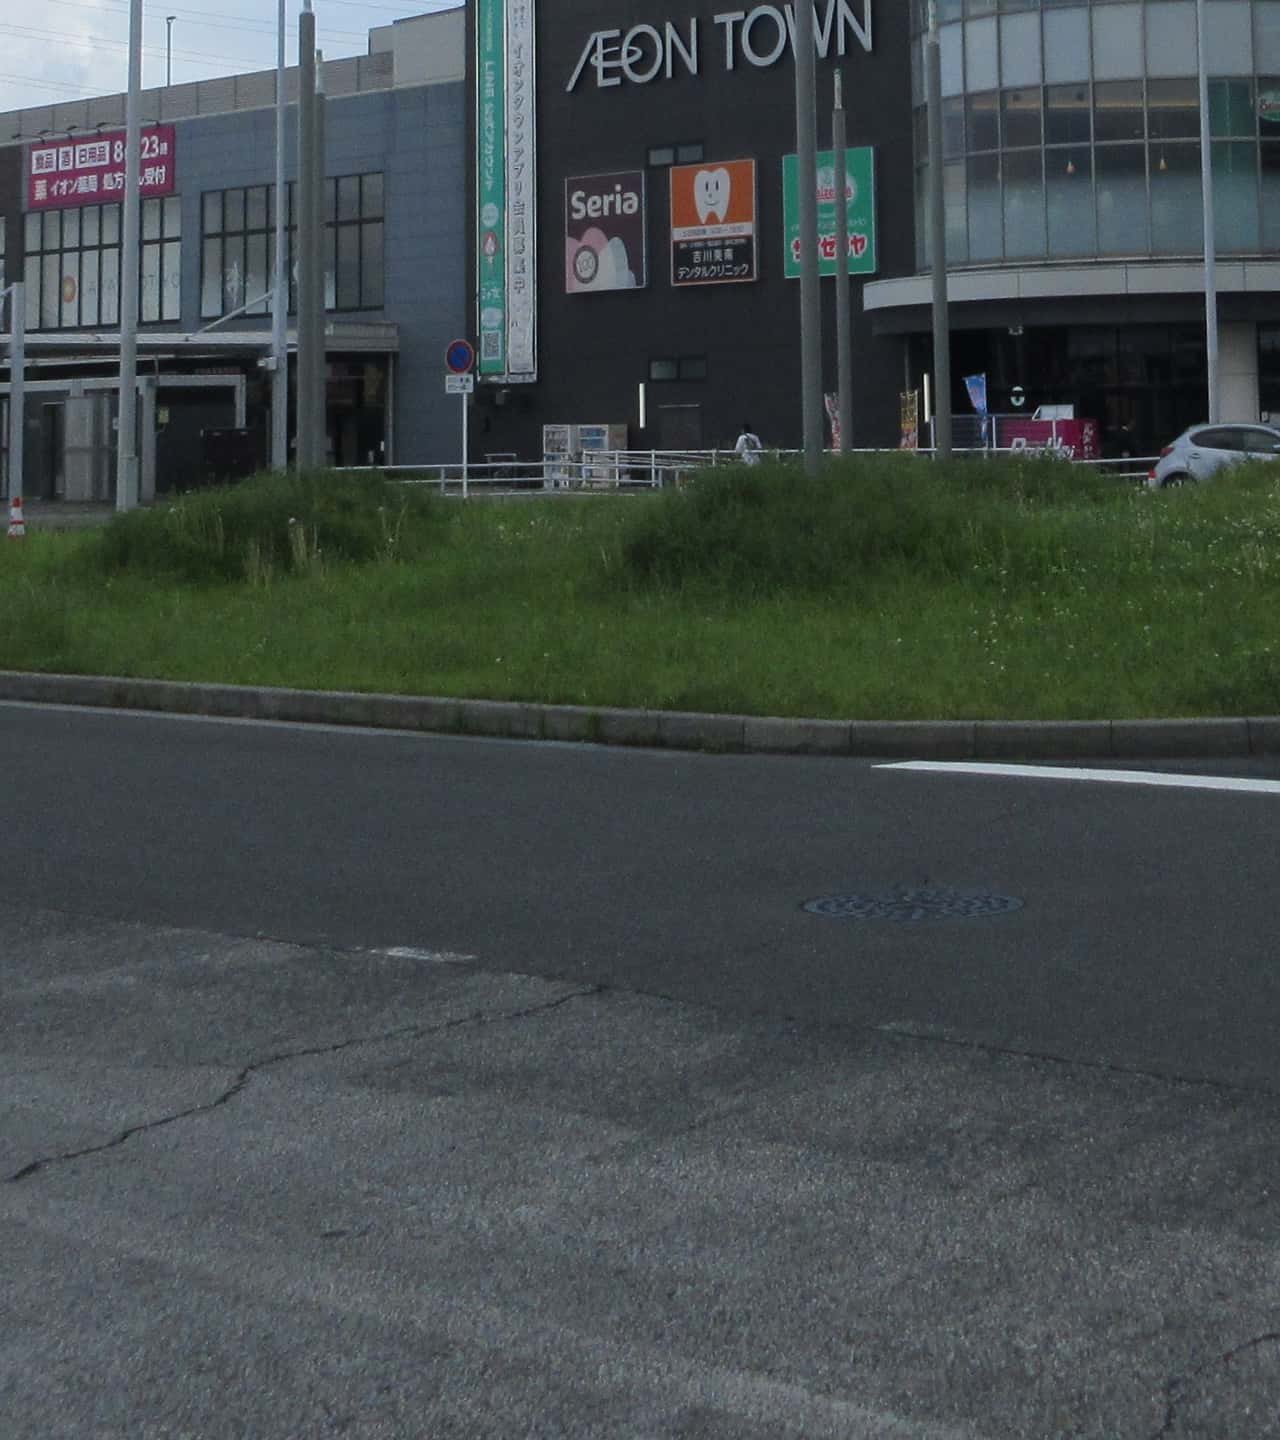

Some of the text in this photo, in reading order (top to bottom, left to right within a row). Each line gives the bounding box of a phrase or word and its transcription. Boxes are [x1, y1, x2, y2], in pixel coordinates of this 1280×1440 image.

[571, 183, 639, 220] Seria
[678, 263, 749, 280] デンタルクリニック
